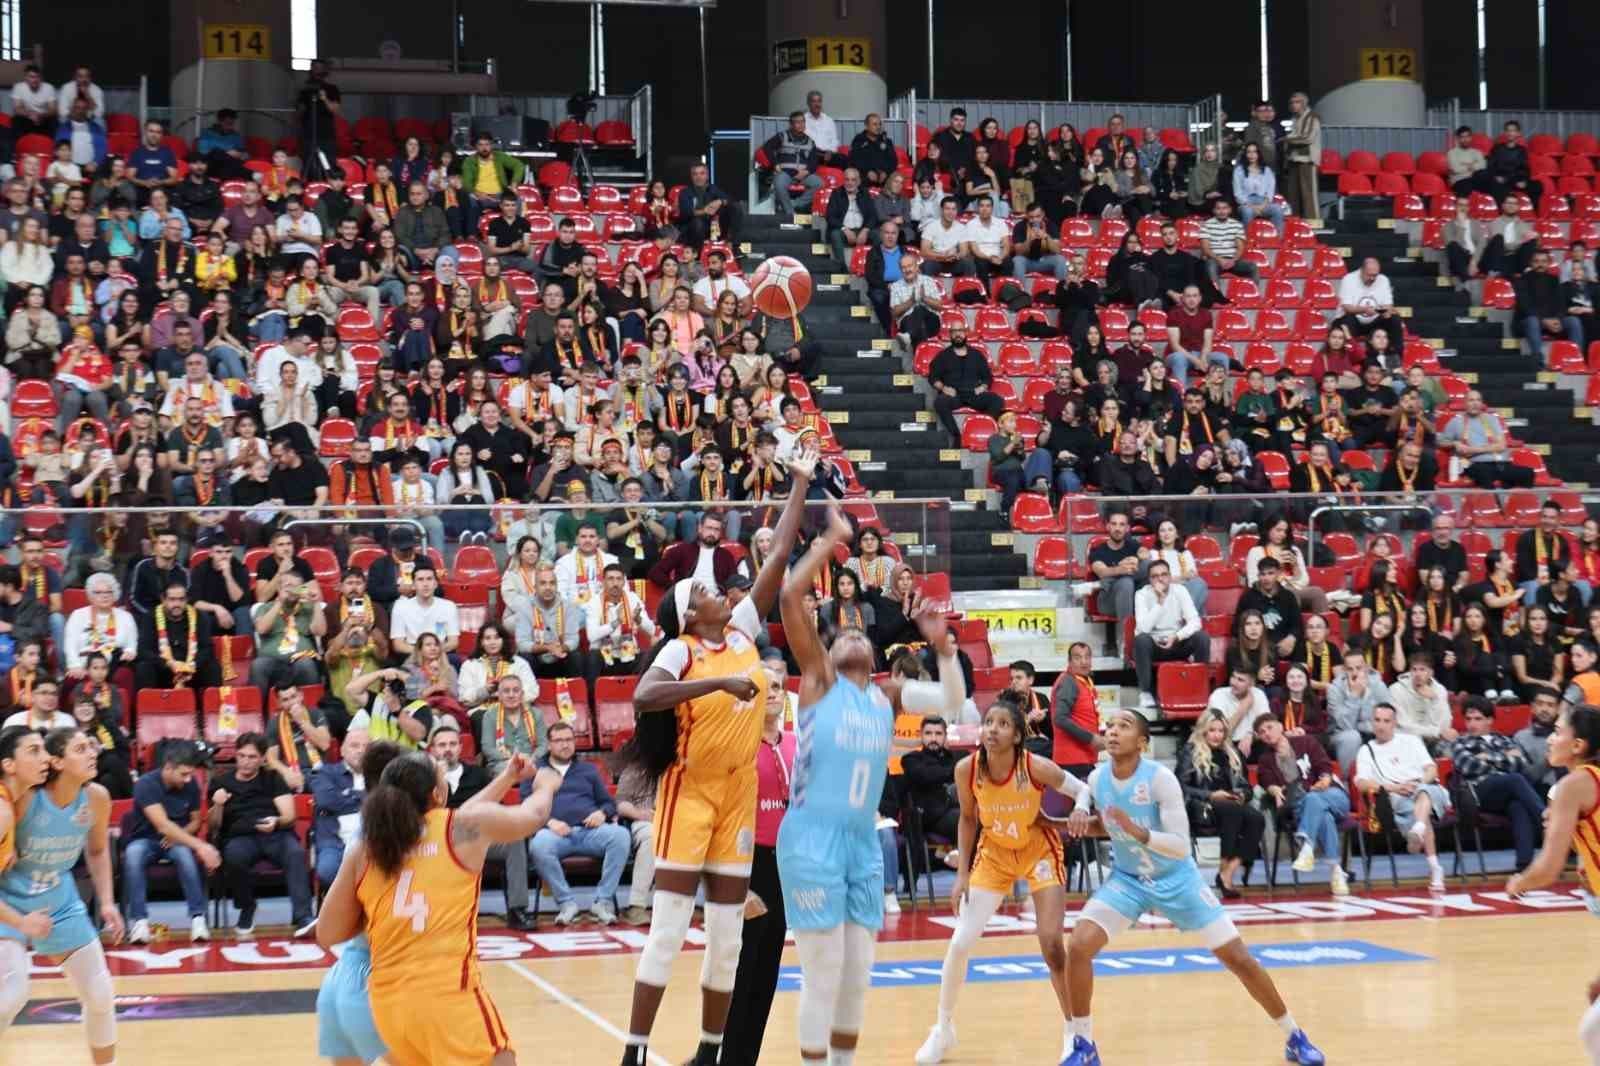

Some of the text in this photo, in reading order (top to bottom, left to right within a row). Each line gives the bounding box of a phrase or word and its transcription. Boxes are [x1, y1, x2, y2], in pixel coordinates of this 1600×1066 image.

[210, 30, 264, 55] 114
[816, 43, 865, 66] 113
[1367, 53, 1411, 76] 112
[1018, 617, 1052, 634] 013
[848, 758, 871, 810] 0
[992, 817, 1019, 839] 24
[392, 868, 430, 933] 4
